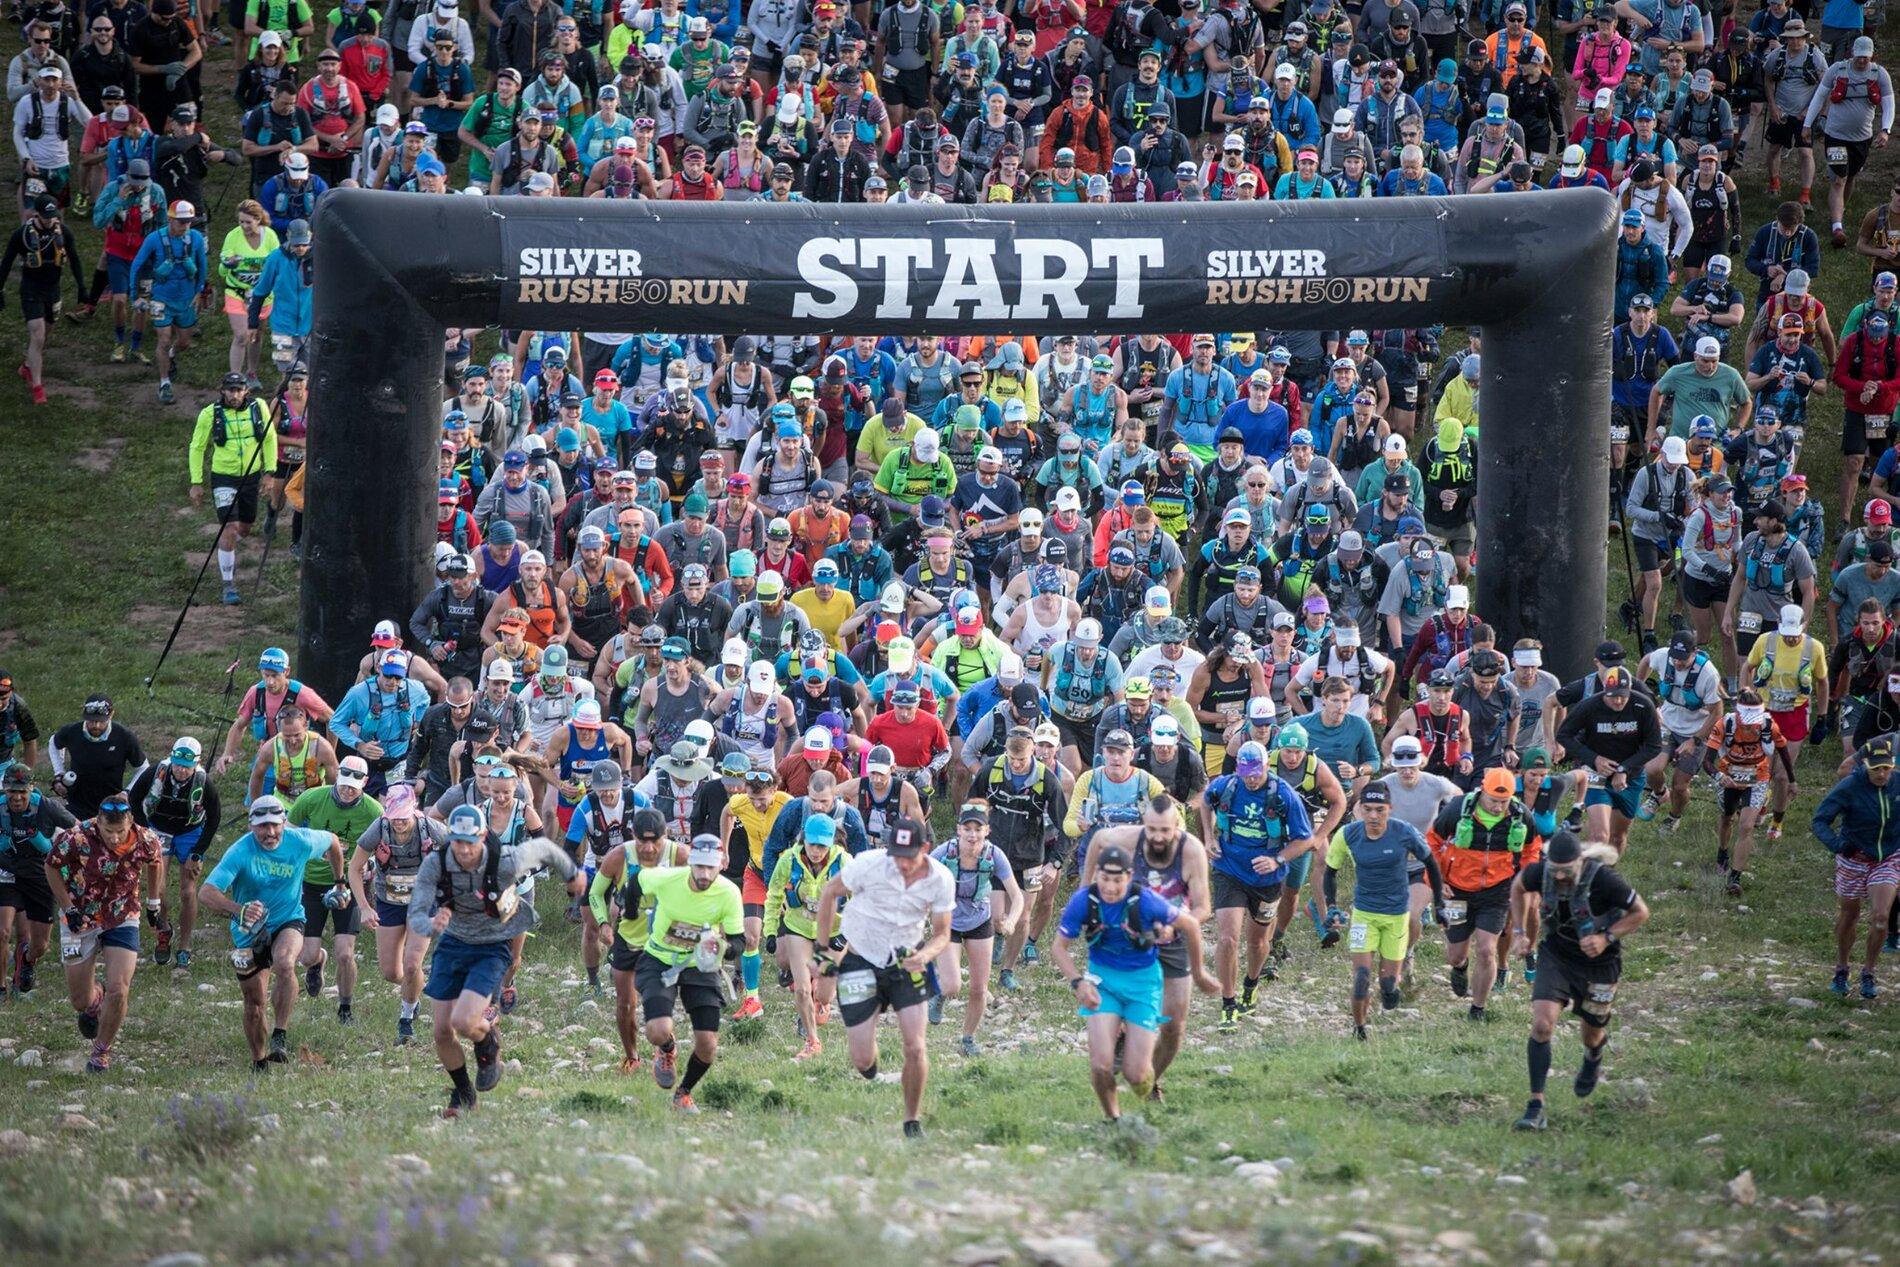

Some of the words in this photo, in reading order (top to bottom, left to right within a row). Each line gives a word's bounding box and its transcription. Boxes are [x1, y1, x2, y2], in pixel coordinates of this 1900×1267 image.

[519, 248, 643, 277] SILVER
[1206, 249, 1326, 278] SILVER
[518, 278, 749, 305] RUSH50RUN
[791, 238, 1164, 320] START
[1205, 278, 1430, 304] RUSH50RUN
[1070, 687, 1089, 699] 50
[1366, 792, 1385, 800] GORE
